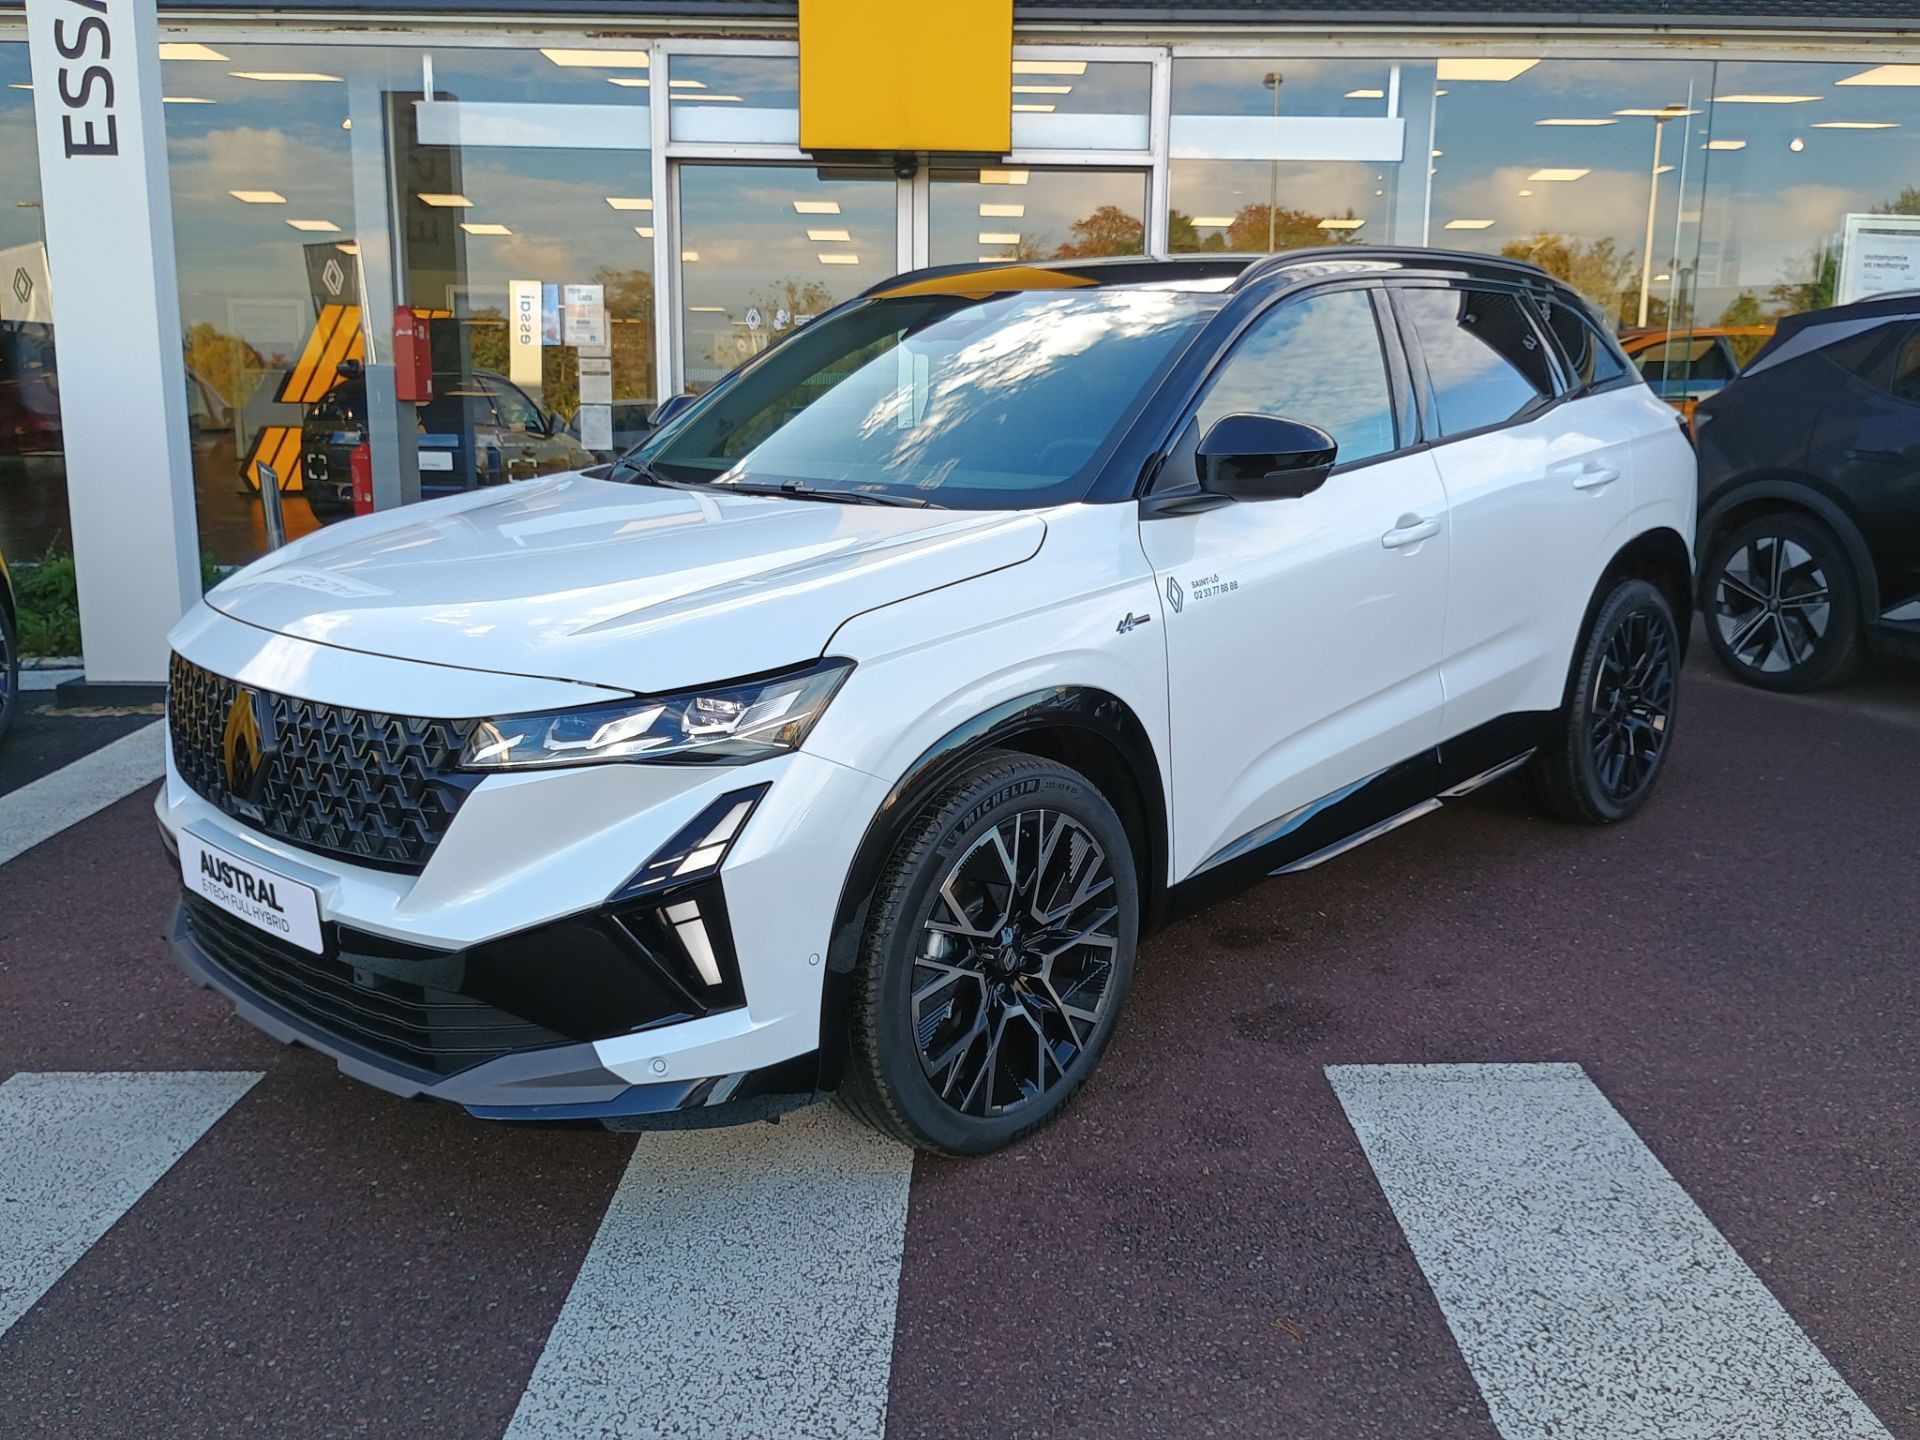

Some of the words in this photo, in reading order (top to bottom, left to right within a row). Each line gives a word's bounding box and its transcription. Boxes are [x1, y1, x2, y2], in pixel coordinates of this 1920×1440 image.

[963, 779, 1038, 830] MICHELIN
[201, 850, 285, 913] AUSTRAL
[231, 897, 251, 916] FULL
[252, 907, 290, 933] HYBRID
